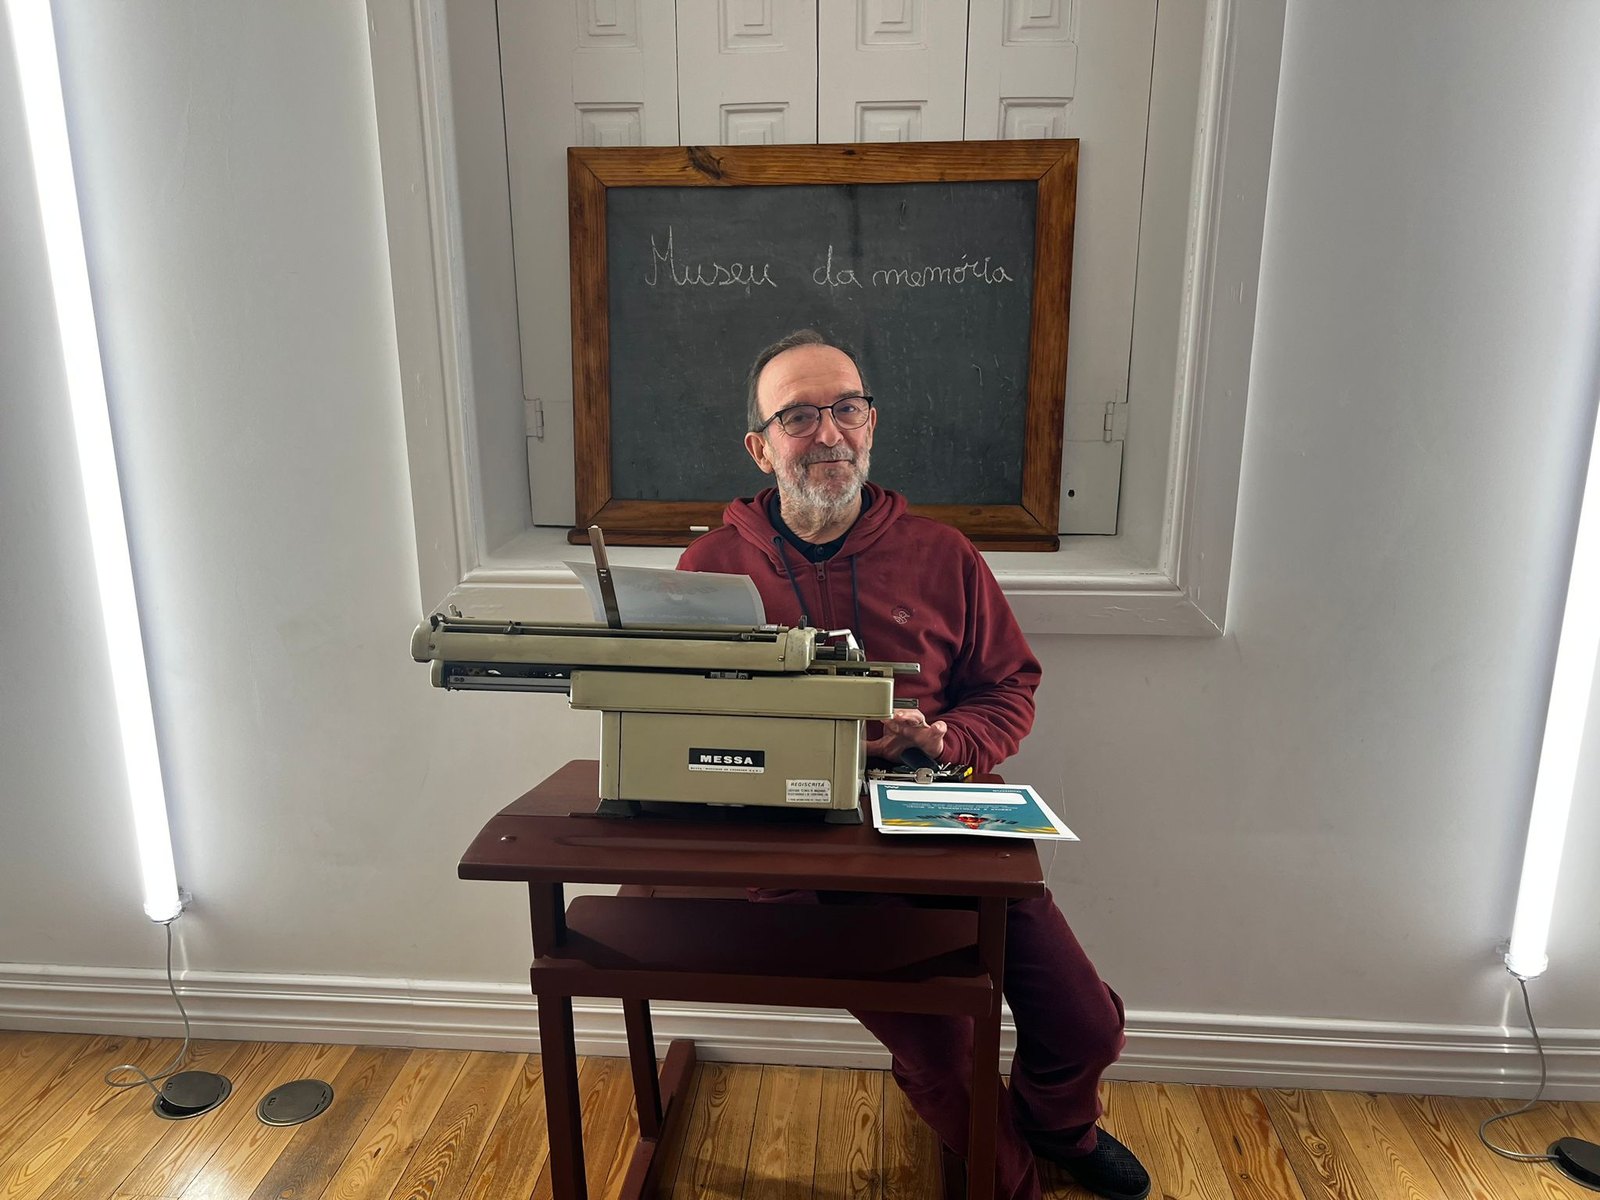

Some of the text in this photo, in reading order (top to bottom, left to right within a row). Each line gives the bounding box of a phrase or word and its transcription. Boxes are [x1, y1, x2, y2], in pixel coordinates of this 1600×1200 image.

[645, 225, 1014, 288] Museu da memória
[700, 755, 753, 765] MESSA
